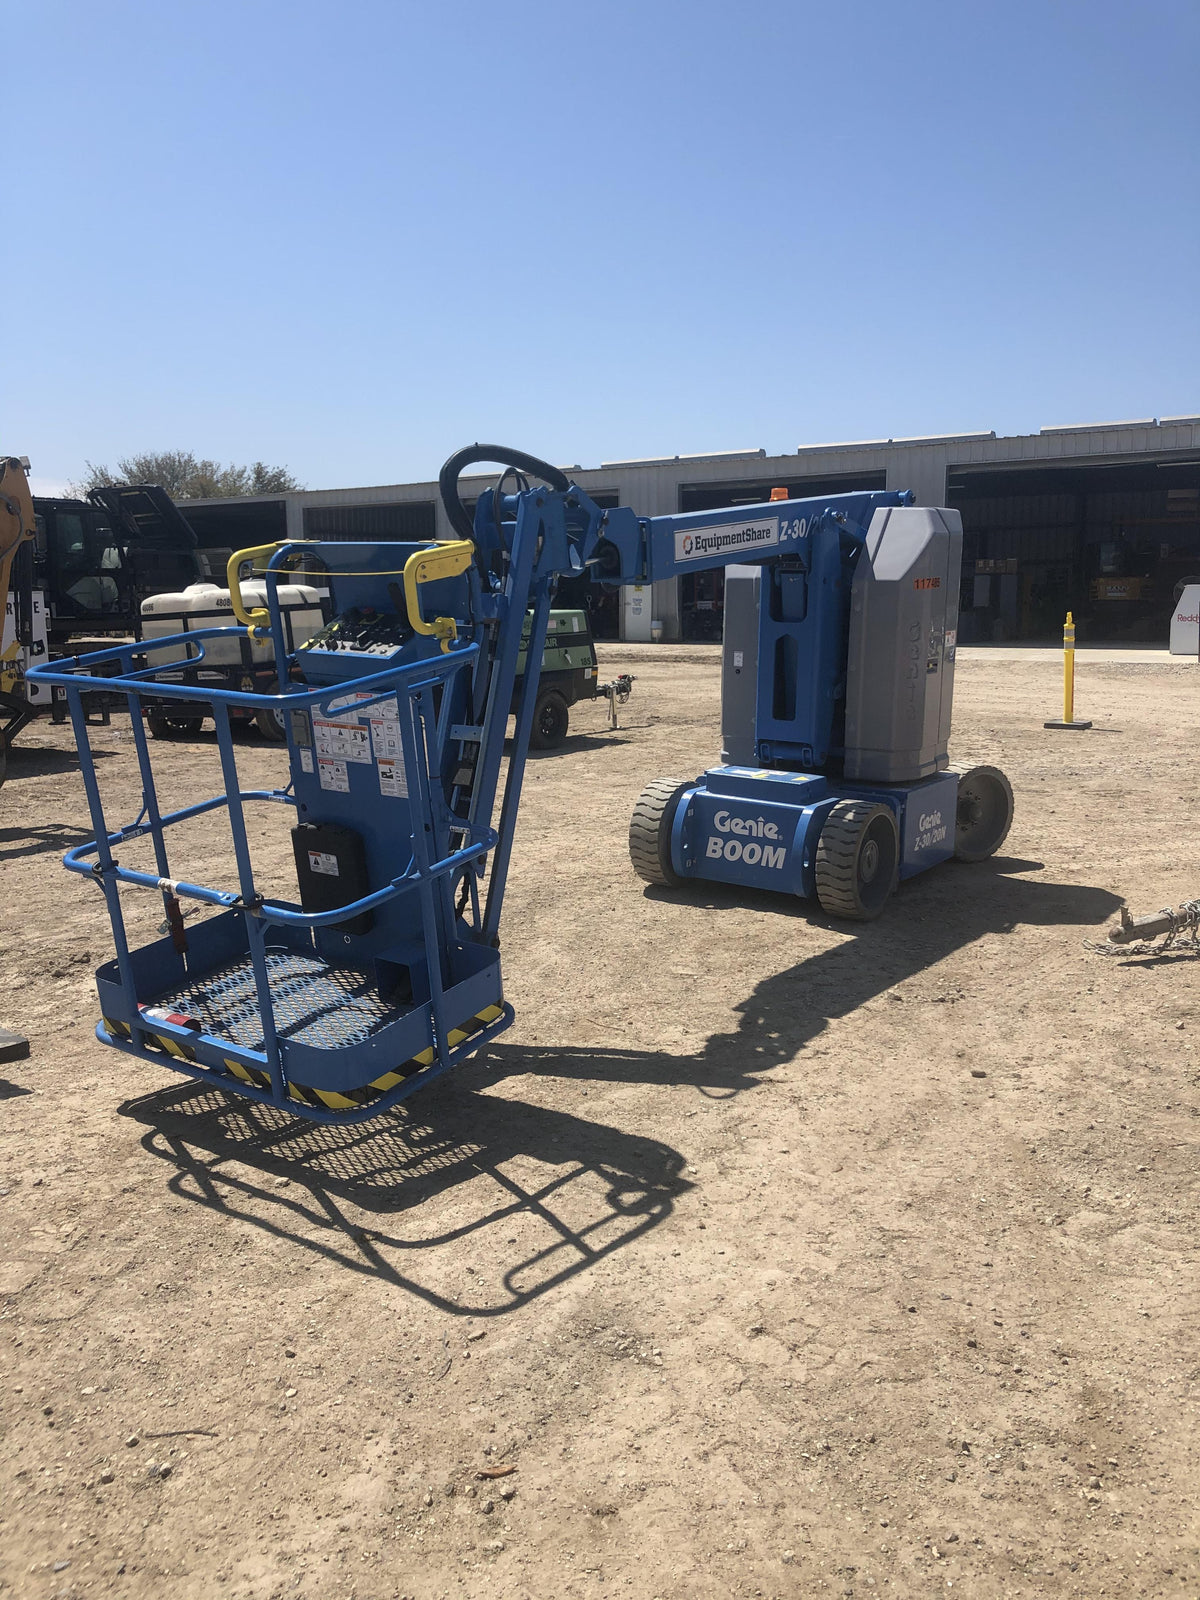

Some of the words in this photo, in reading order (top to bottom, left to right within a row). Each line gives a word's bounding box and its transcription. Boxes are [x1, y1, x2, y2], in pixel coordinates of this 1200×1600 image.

[695, 528, 771, 553] EquipmentShare
[216, 598, 232, 607] 4808
[919, 810, 941, 832] Genie
[706, 836, 787, 869] BOOM
